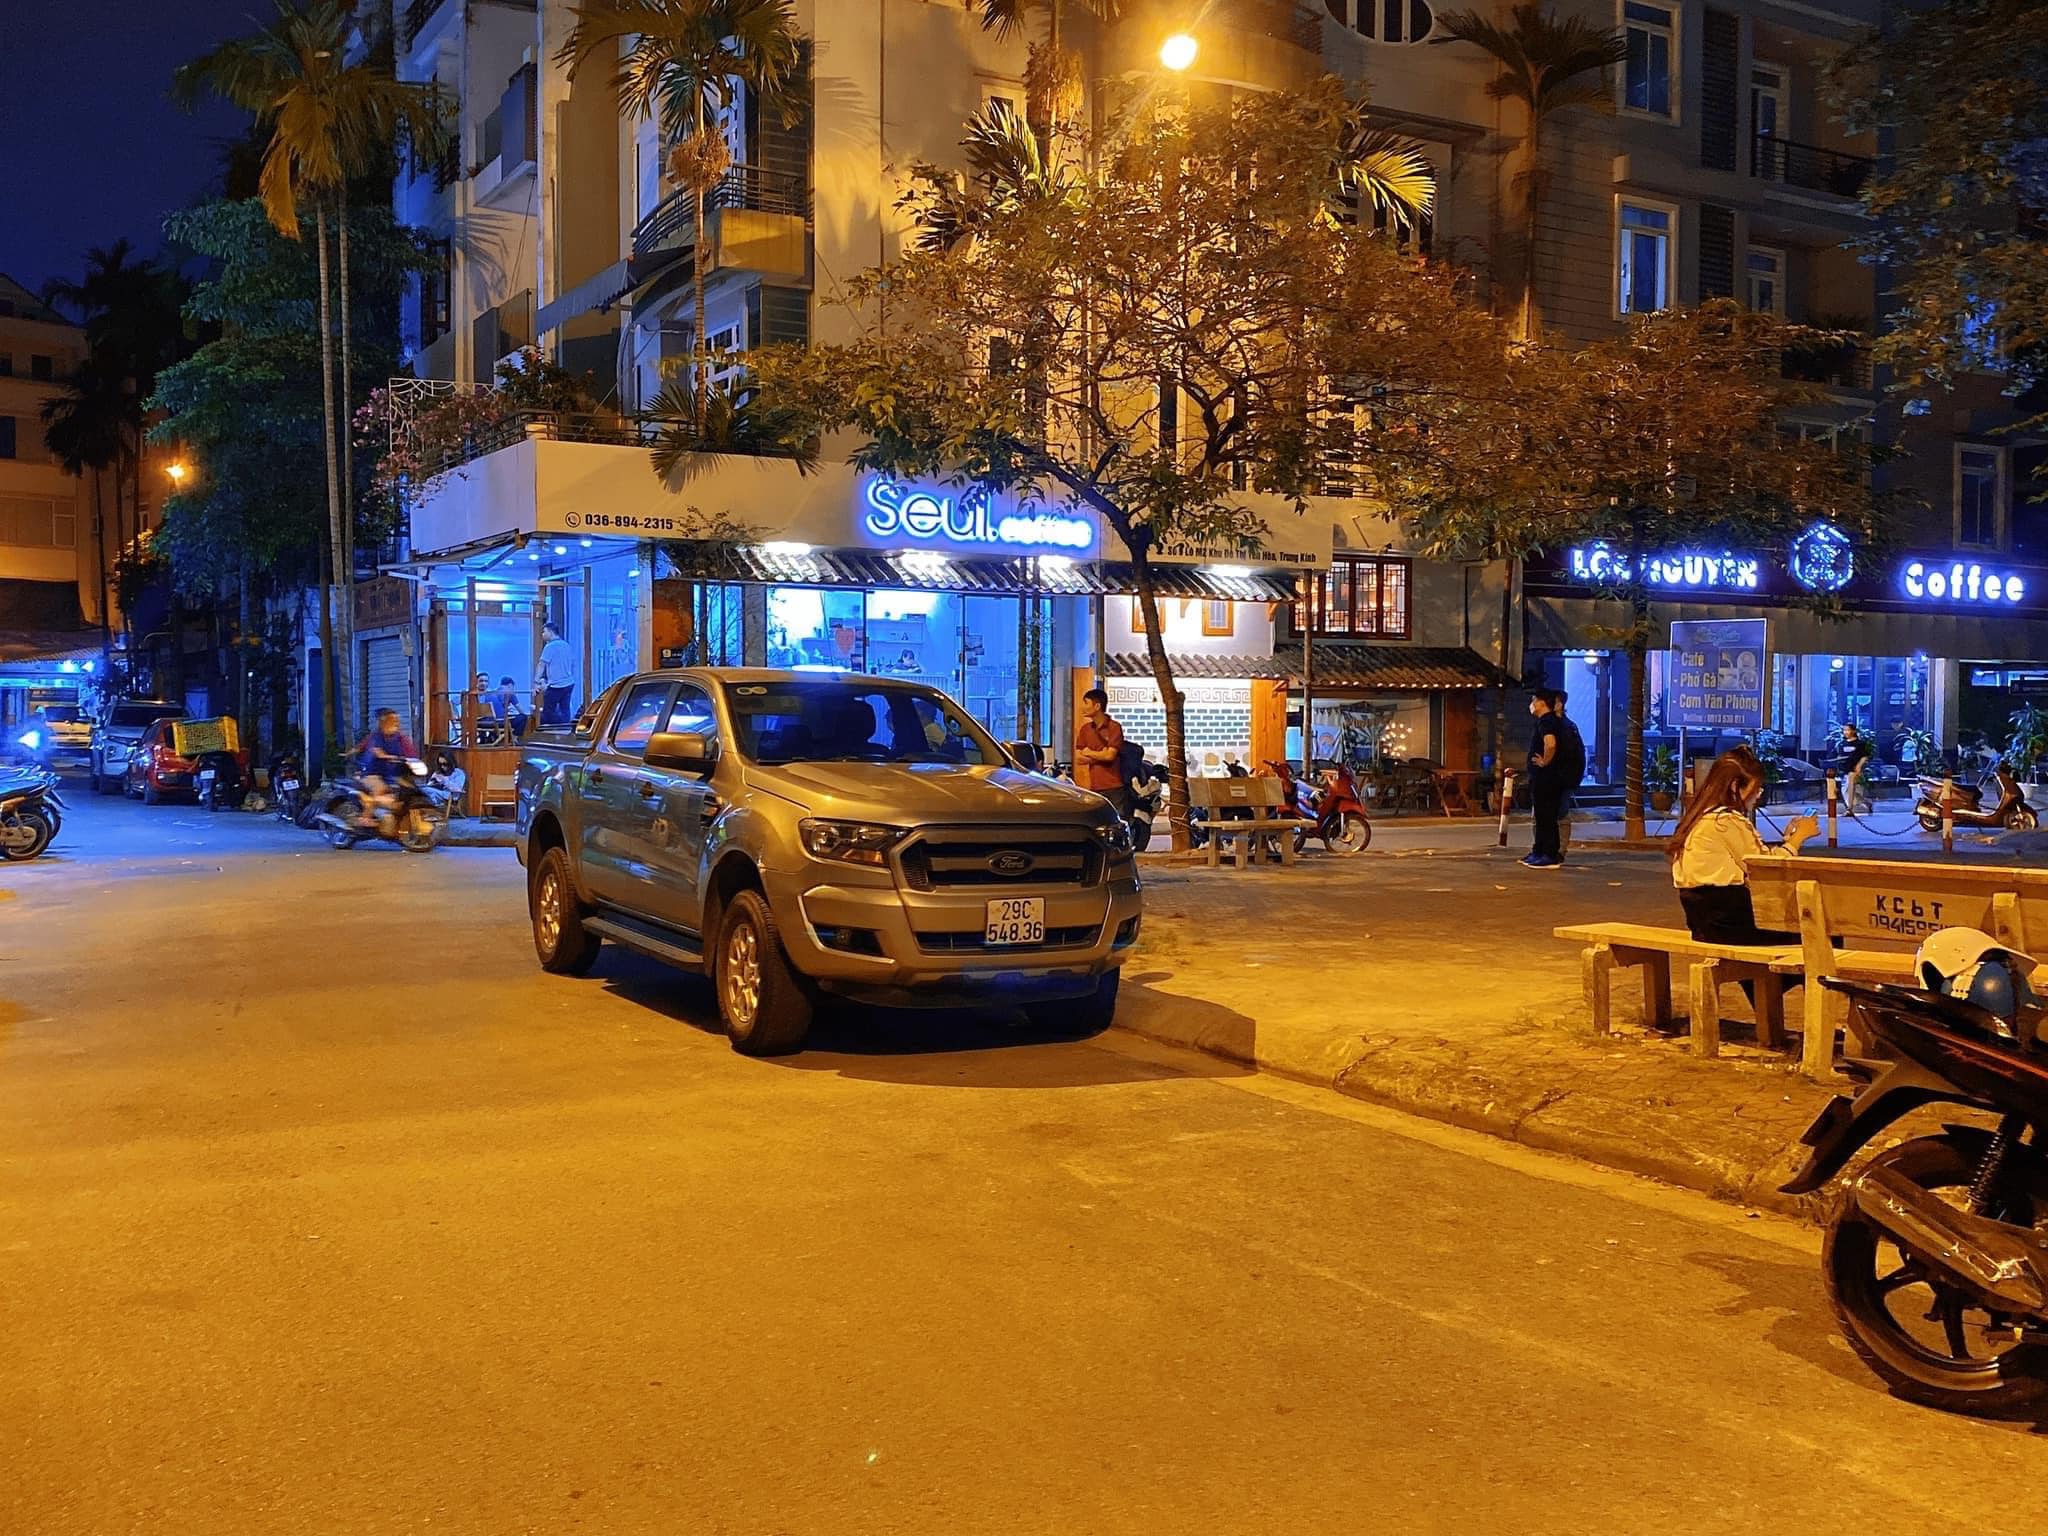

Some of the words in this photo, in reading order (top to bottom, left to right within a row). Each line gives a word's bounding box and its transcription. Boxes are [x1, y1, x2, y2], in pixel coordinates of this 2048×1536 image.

[585, 514, 673, 530] 036-894-2315
[1905, 563, 2024, 602] Coffee
[1000, 856, 1025, 869] Ford
[1001, 900, 1032, 921] 29C
[987, 921, 1043, 943] 548.36
